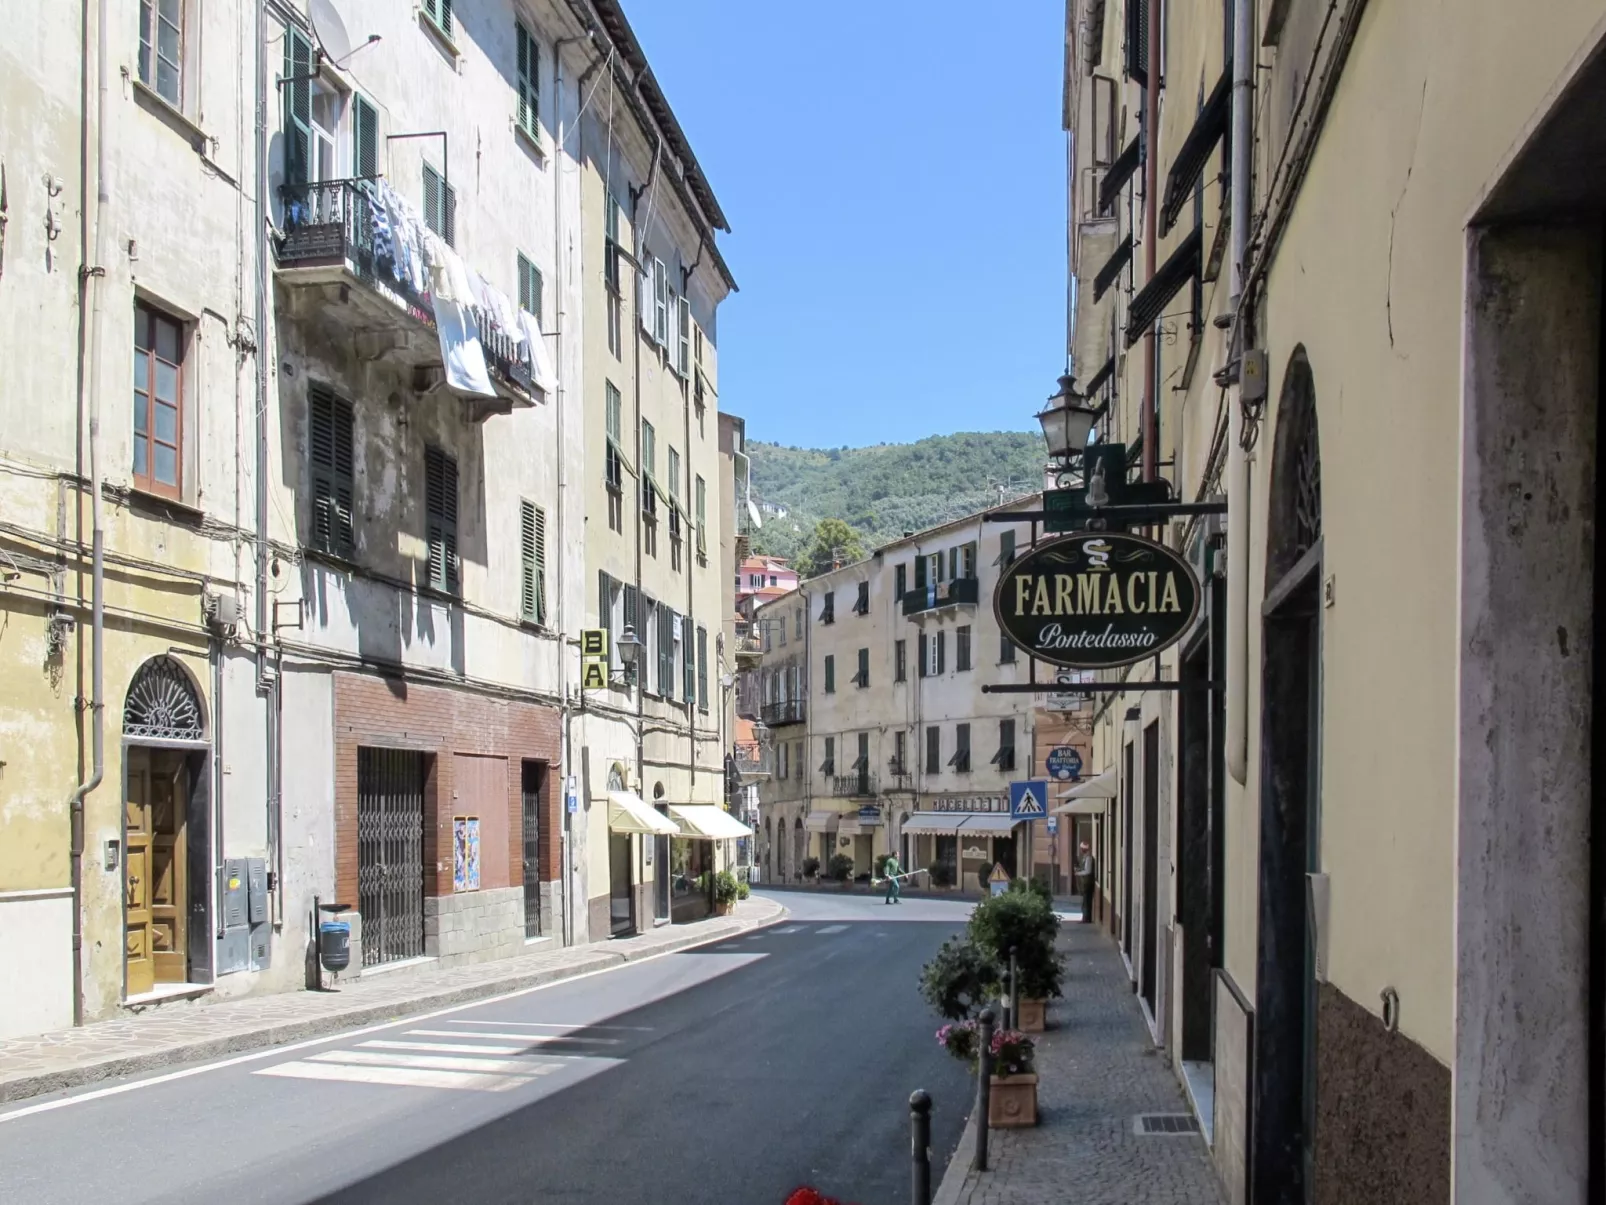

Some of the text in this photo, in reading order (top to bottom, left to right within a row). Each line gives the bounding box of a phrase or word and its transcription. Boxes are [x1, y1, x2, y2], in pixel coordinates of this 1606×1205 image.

[1015, 571, 1182, 616] FARMACIA
[1035, 623, 1158, 649] Pontedassio
[1057, 749, 1072, 757] BAR
